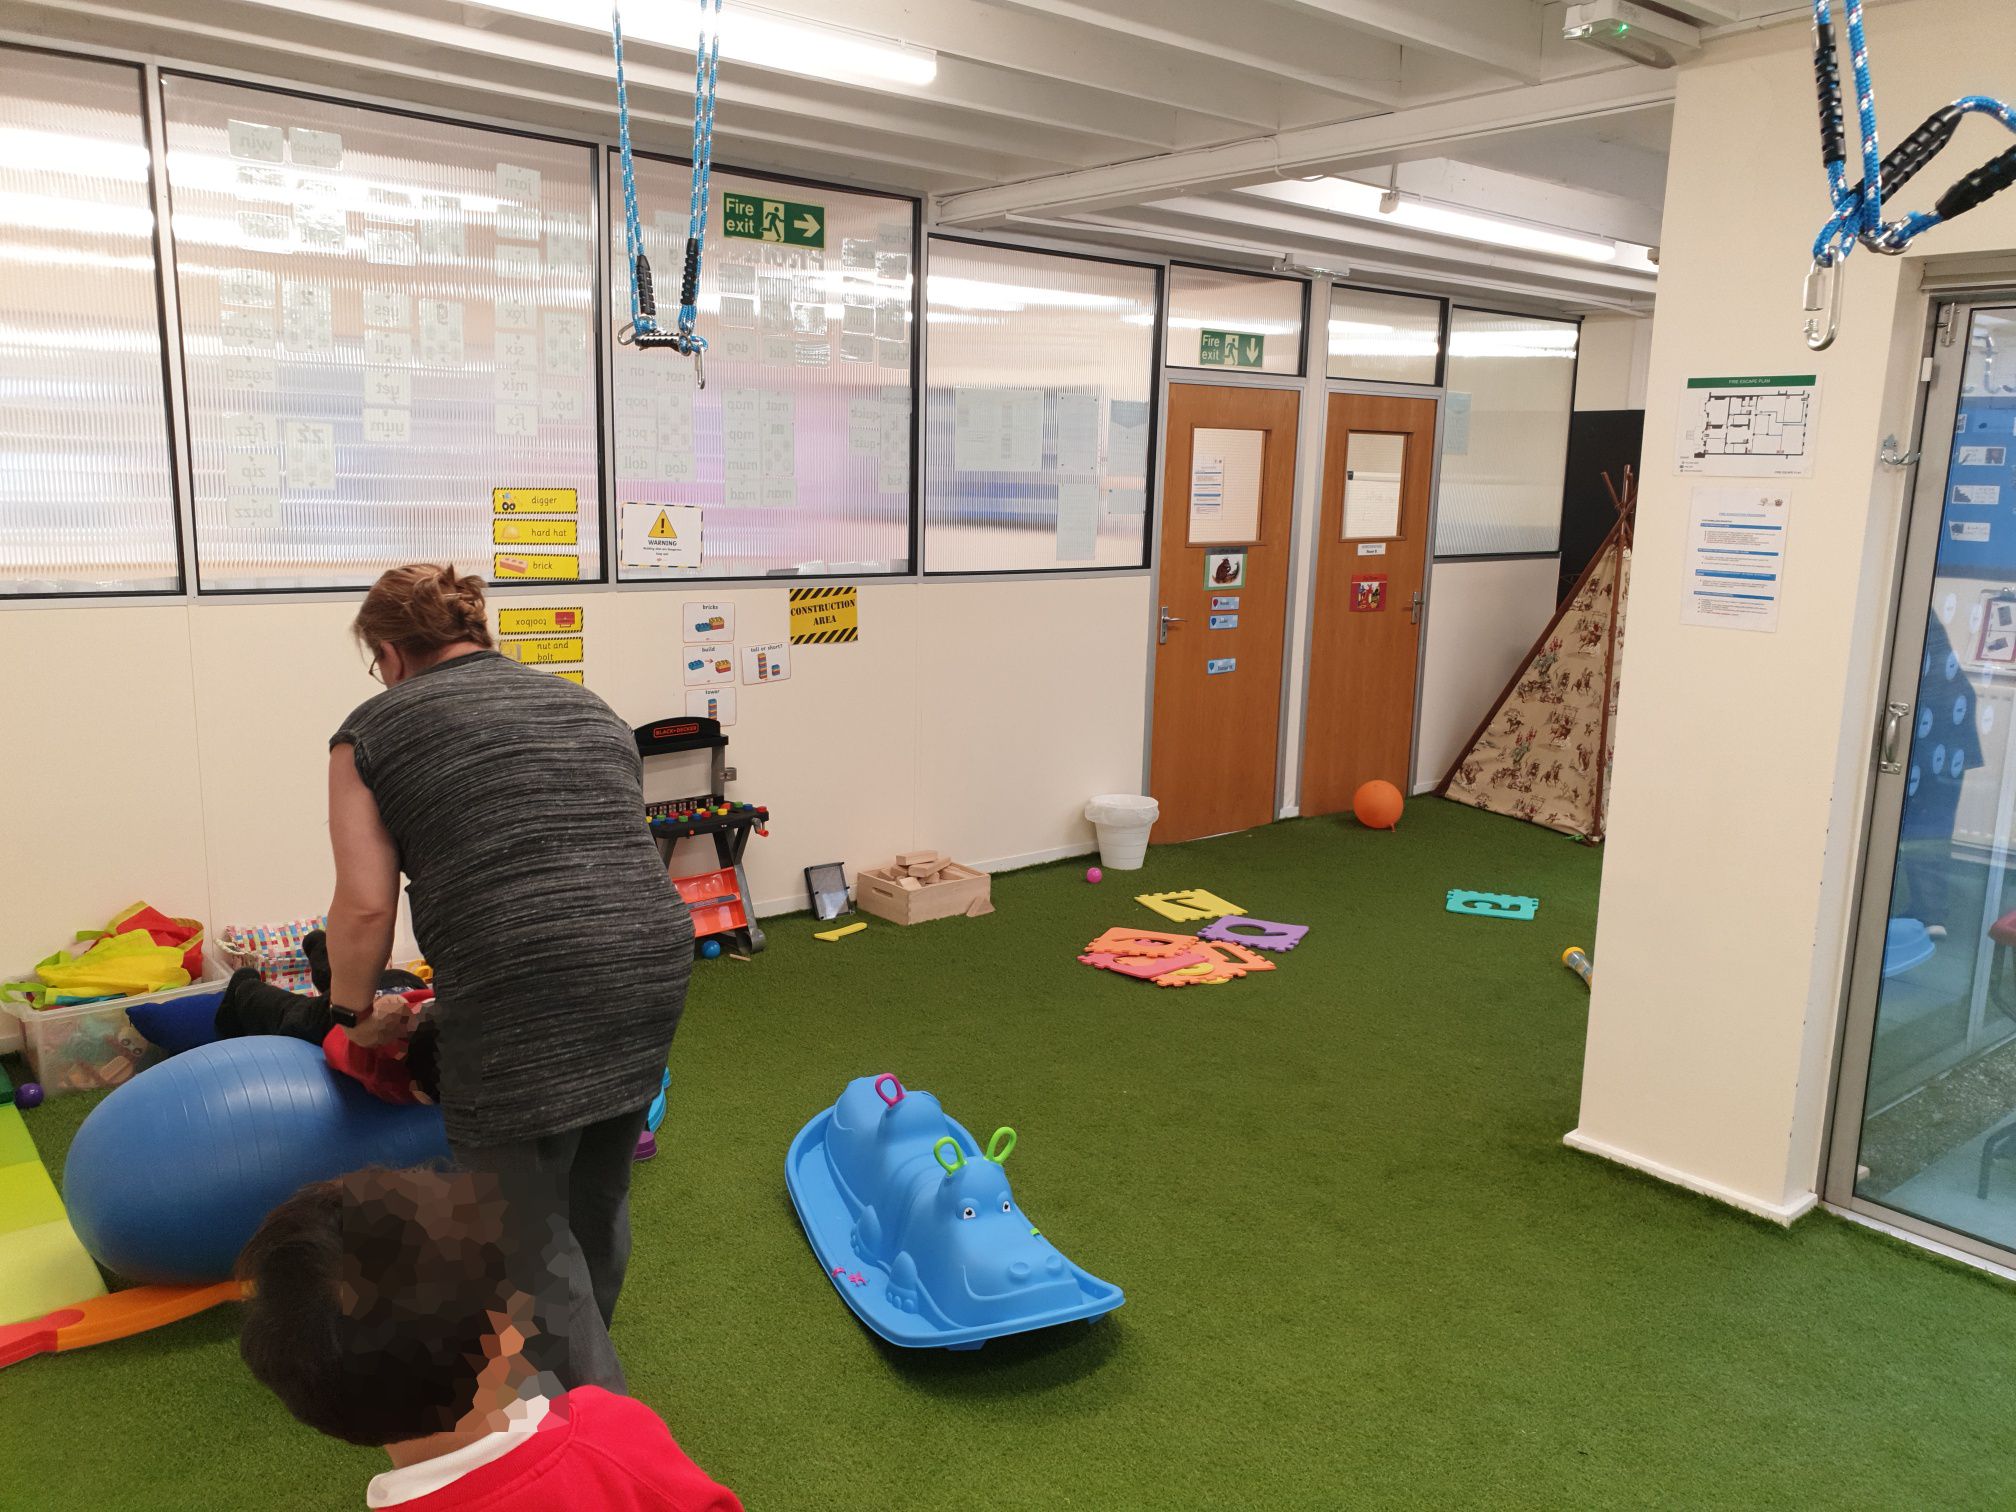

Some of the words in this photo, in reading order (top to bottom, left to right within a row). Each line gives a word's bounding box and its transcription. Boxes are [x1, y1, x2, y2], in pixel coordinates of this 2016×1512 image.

[726, 198, 754, 216] Fire
[726, 218, 755, 234] exit
[1202, 334, 1220, 347] Fire
[1201, 348, 1219, 361] exit
[531, 496, 557, 505] digger
[531, 529, 550, 537] hard
[553, 529, 567, 537] hat
[532, 561, 553, 570] brick
[790, 599, 856, 616] CONSTRUCTION
[515, 618, 547, 627] toolbox
[813, 615, 837, 626] AREA
[553, 641, 569, 649] and
[537, 653, 554, 662] bolt
